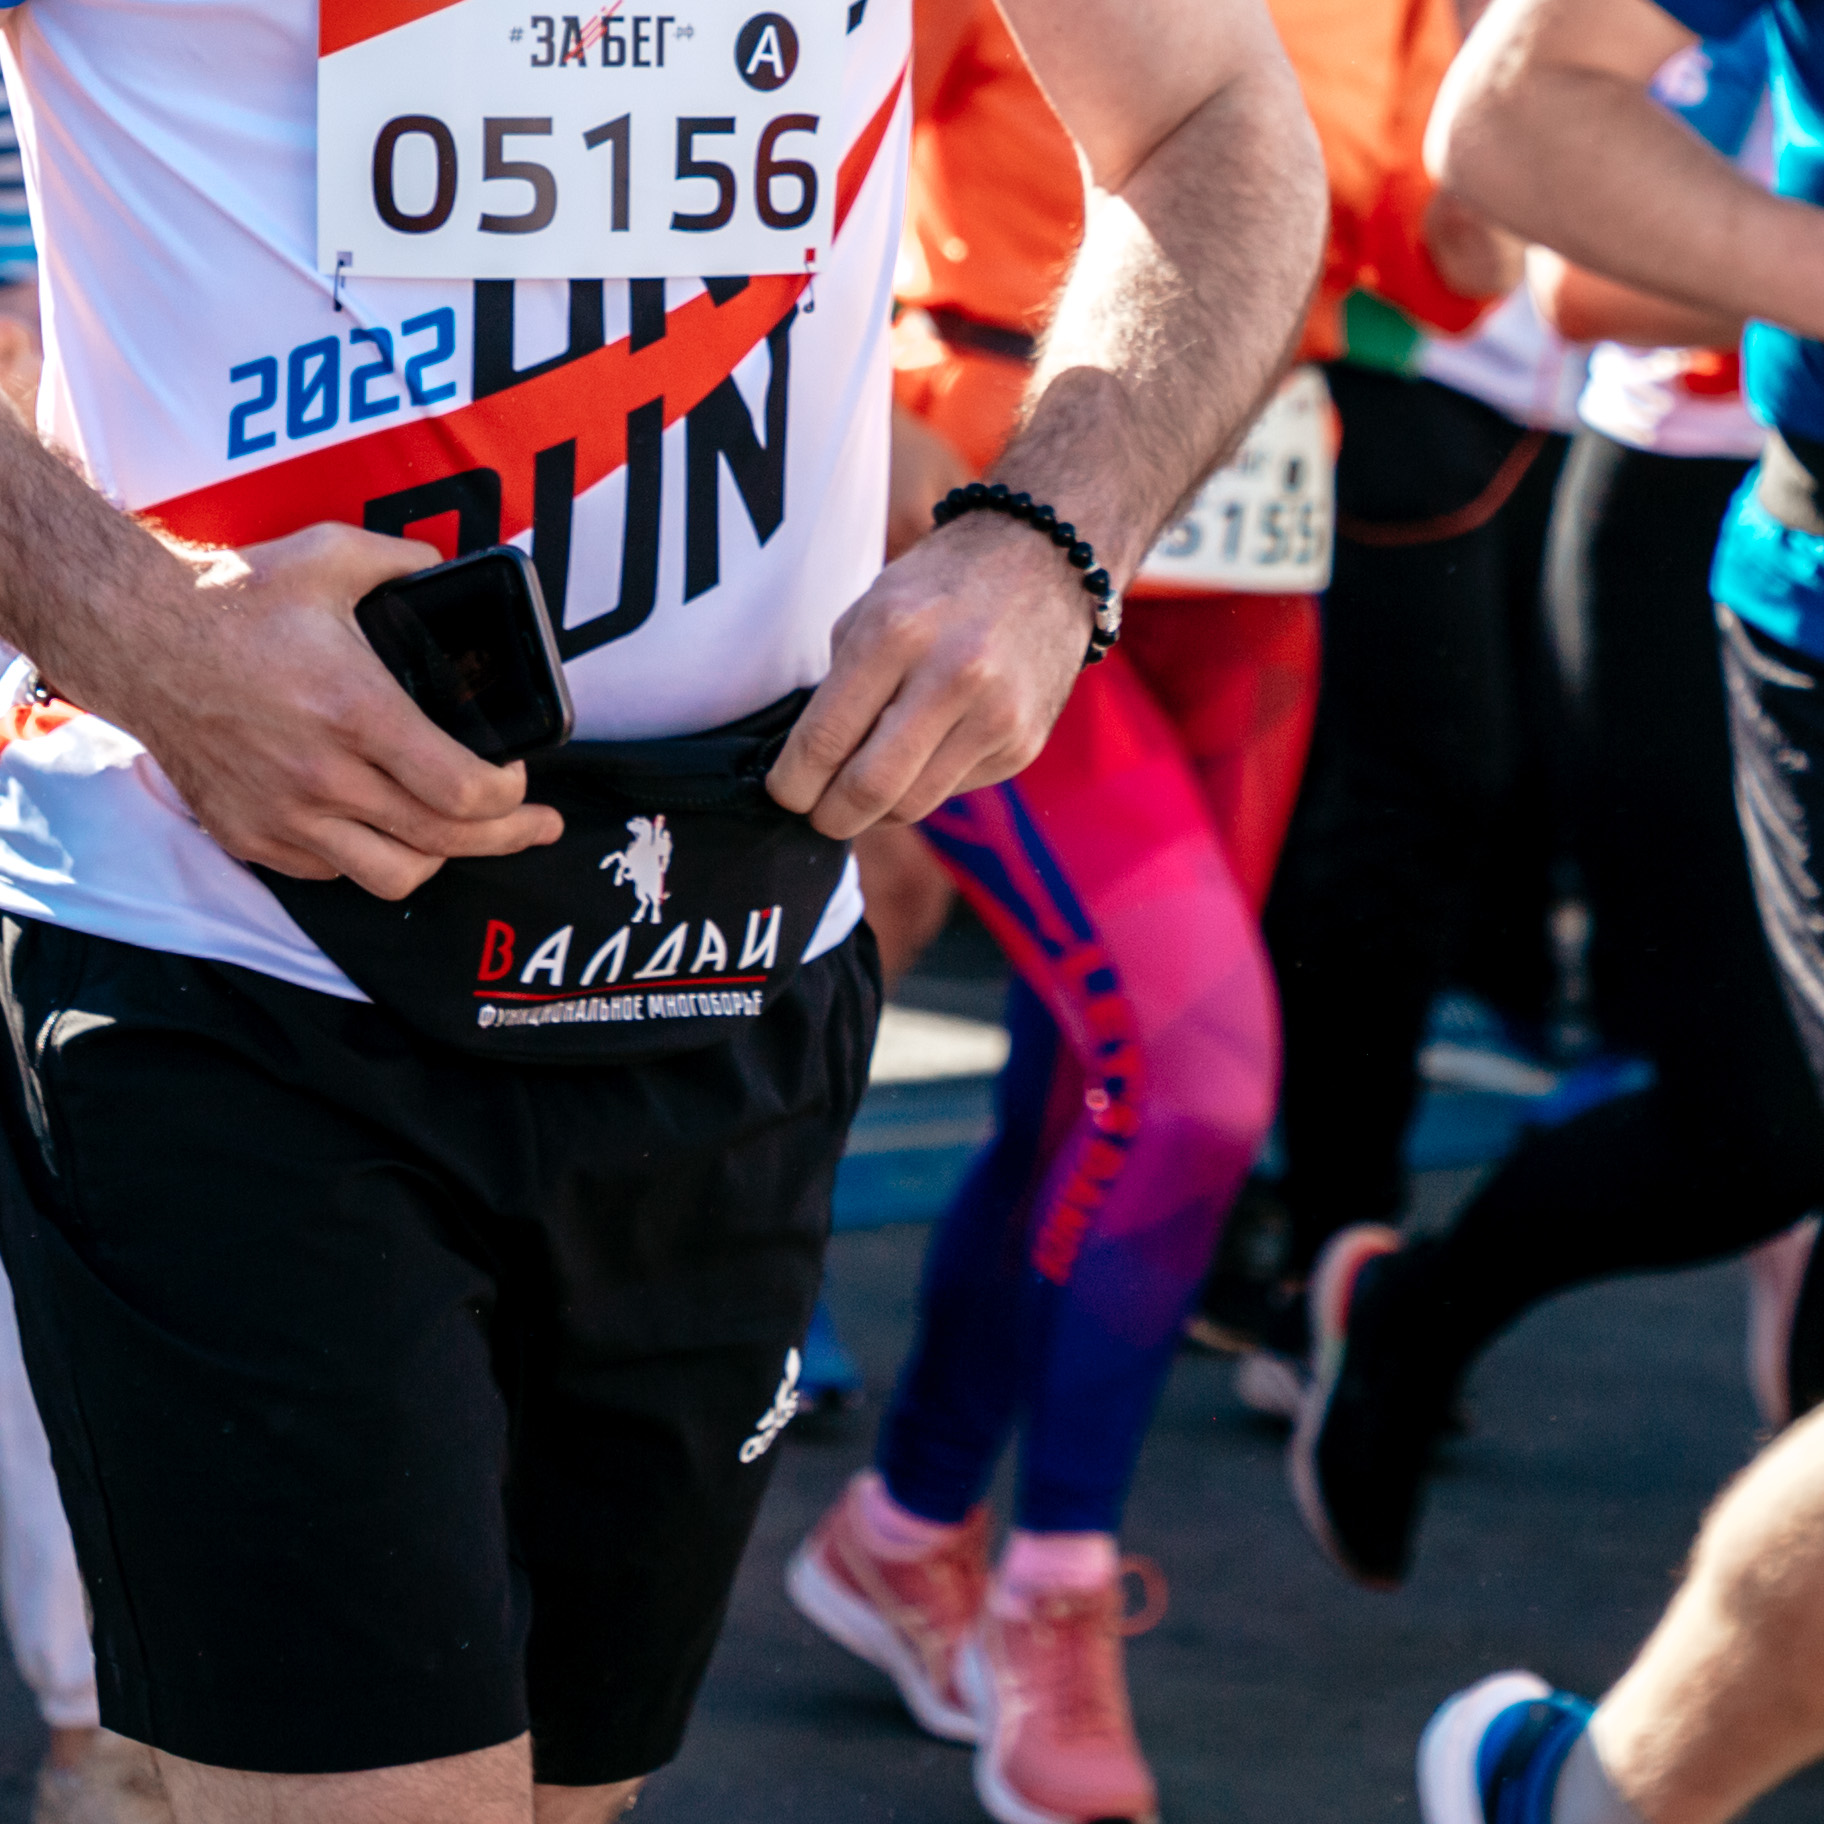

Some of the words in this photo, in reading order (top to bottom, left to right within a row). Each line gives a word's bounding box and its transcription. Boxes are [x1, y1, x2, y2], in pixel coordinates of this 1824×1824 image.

[371, 112, 821, 235] 05156
[226, 305, 458, 461] 2022
[477, 904, 783, 987] ВАЛДАЙ
[647, 989, 763, 1019] МНОГОБОРЬЕ
